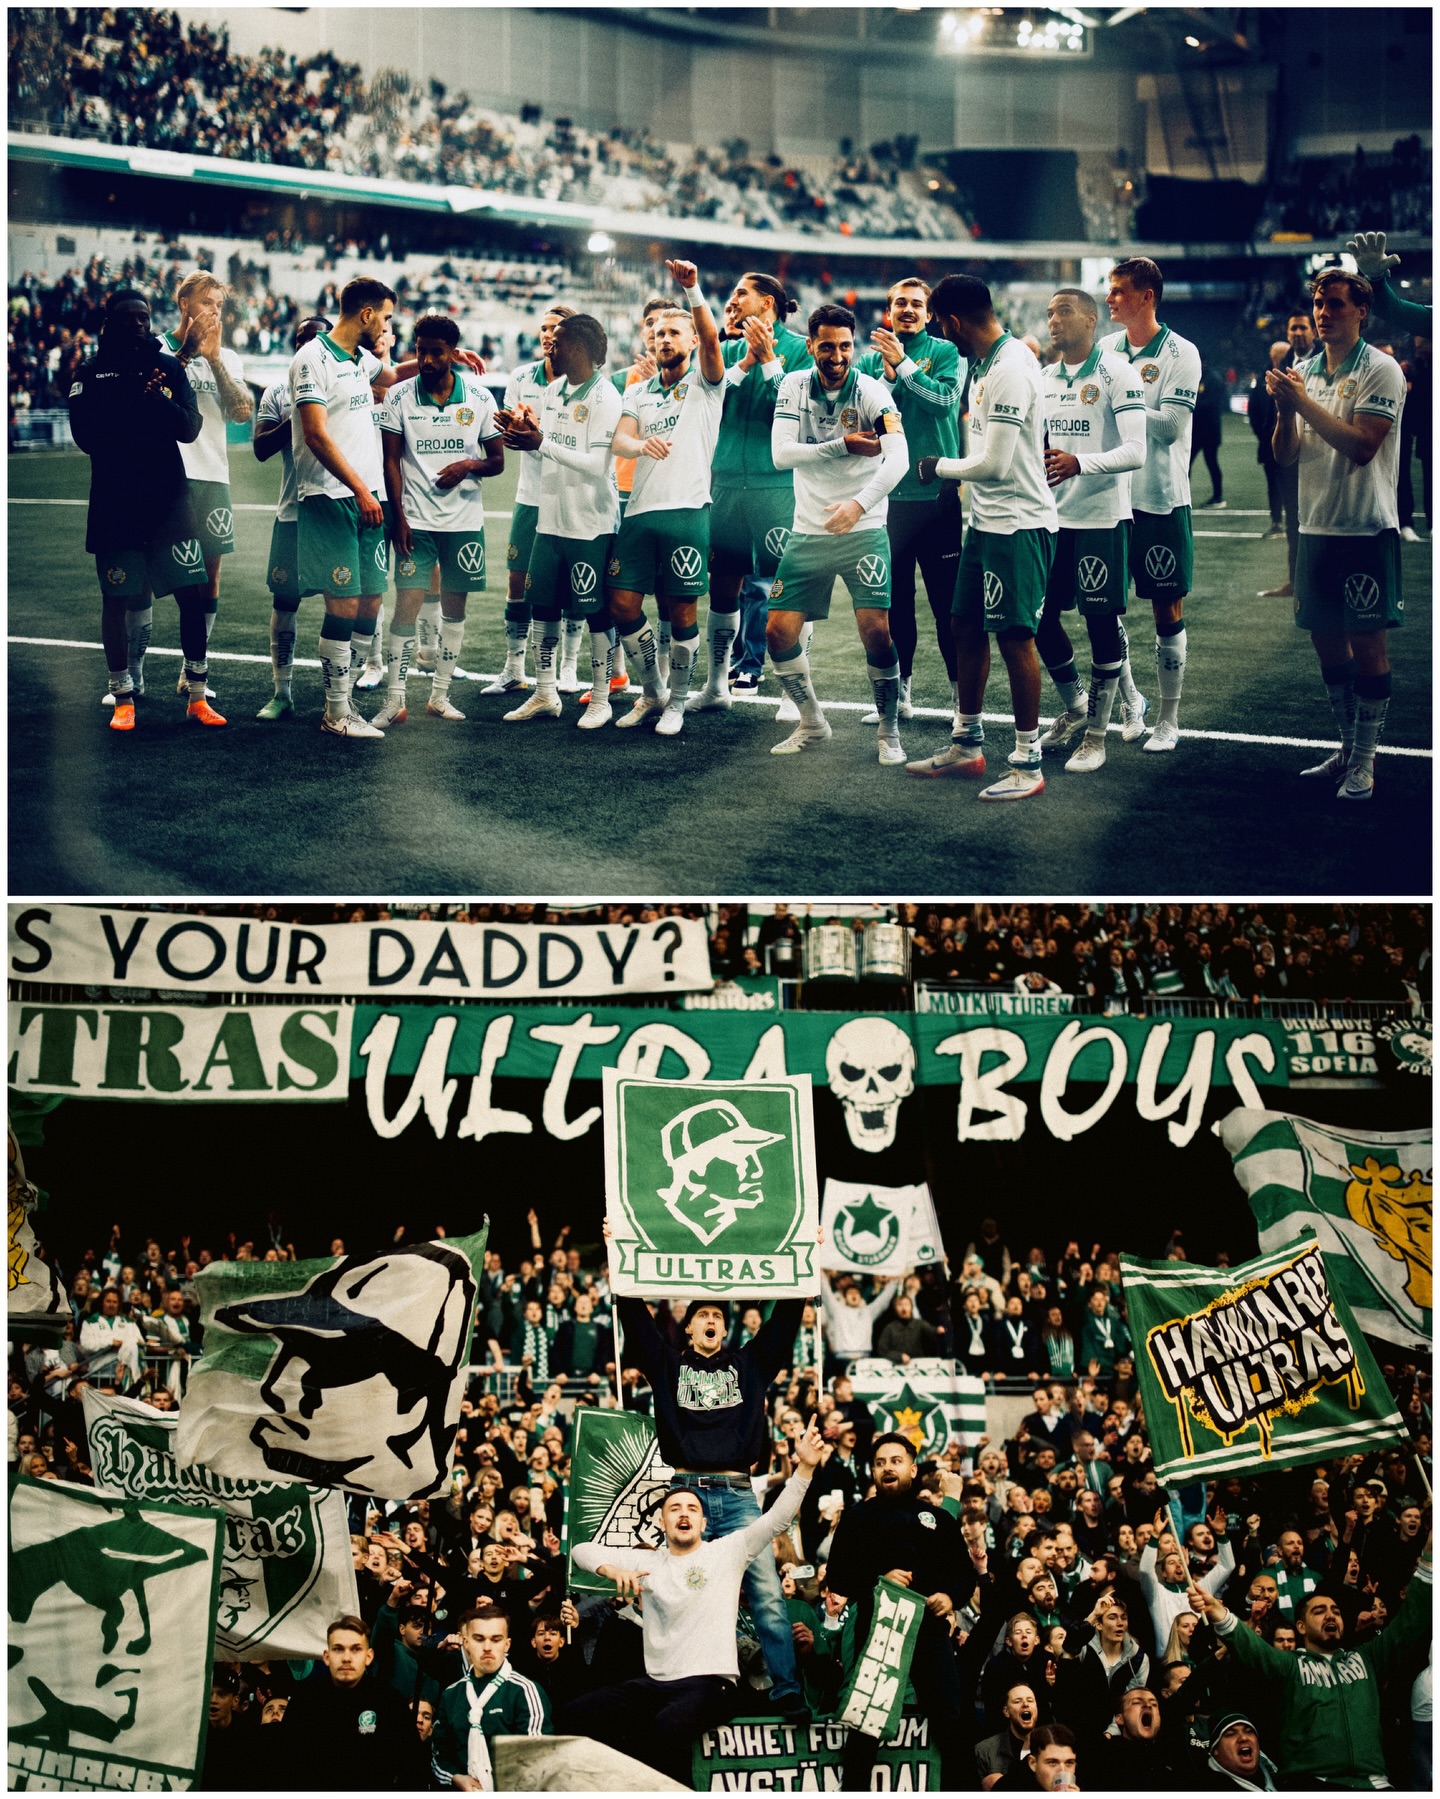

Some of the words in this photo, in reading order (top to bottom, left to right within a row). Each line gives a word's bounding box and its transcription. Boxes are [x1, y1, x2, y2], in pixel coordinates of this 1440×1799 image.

[1175, 388, 1196, 399] BST
[1369, 395, 1395, 408] BST
[993, 404, 1019, 416] BST
[1050, 419, 1090, 432] PROJOB
[416, 438, 465, 451] PROJOB
[1088, 679, 1106, 719] linton
[11, 907, 52, 973] S
[100, 914, 326, 986] YOUR
[368, 920, 683, 987] DADDY?
[8, 1005, 338, 1091] TRAS
[1286, 1031, 1376, 1055] 116
[1290, 1055, 1378, 1073] SOFIA
[935, 1018, 1276, 1147] BOYS
[654, 1257, 777, 1281] ULTRAS
[702, 1725, 796, 1757] FRIHET
